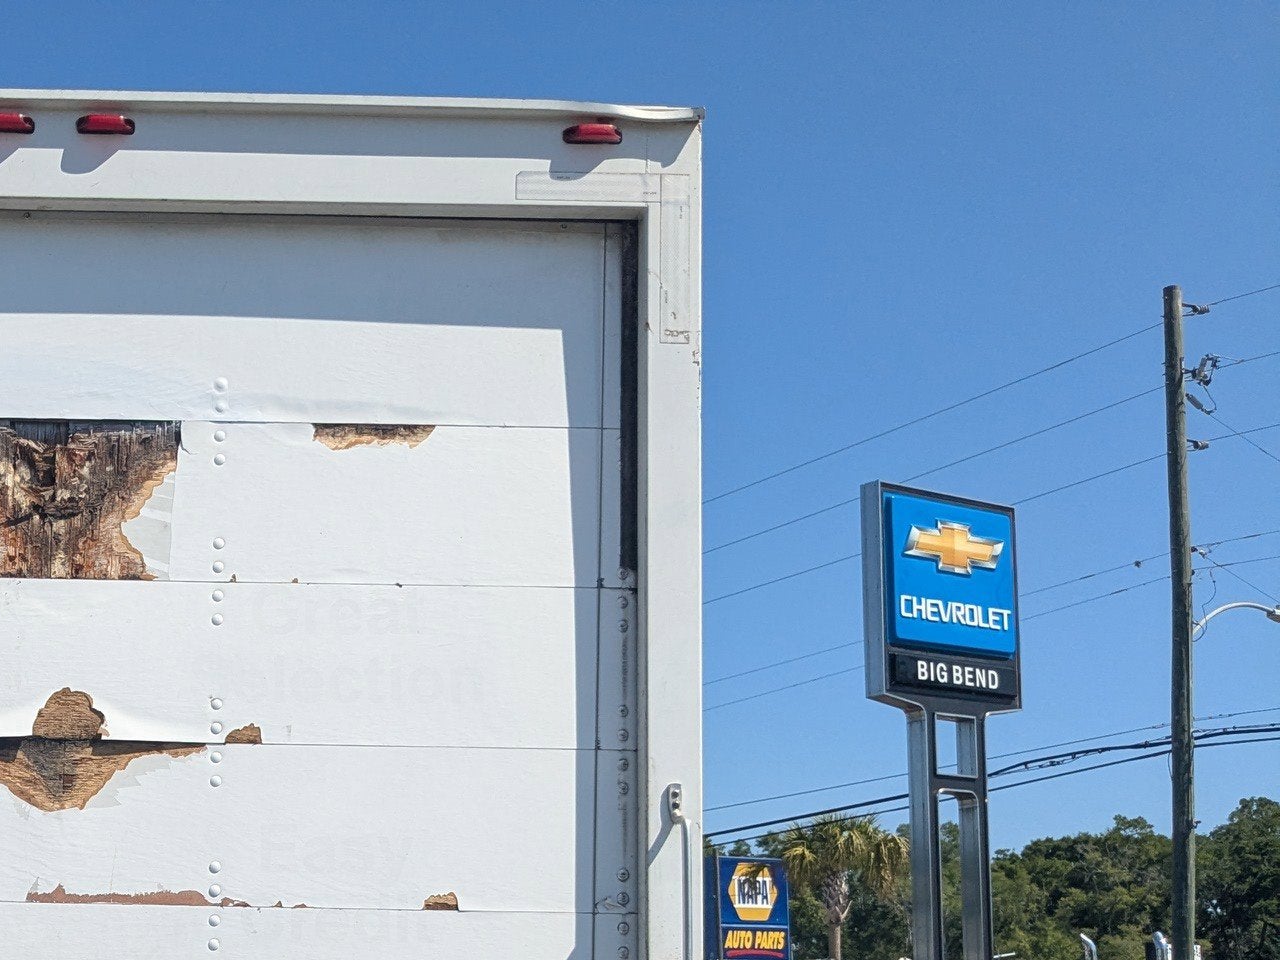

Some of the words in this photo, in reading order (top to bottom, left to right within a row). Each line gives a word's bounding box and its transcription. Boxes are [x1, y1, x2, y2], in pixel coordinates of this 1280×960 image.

[900, 594, 1011, 631] CHEVROLET
[917, 660, 948, 683] BIG
[953, 664, 999, 690] BEND
[737, 878, 769, 905] NAPA
[724, 930, 753, 949] AUTO
[754, 931, 785, 949] PARTS
